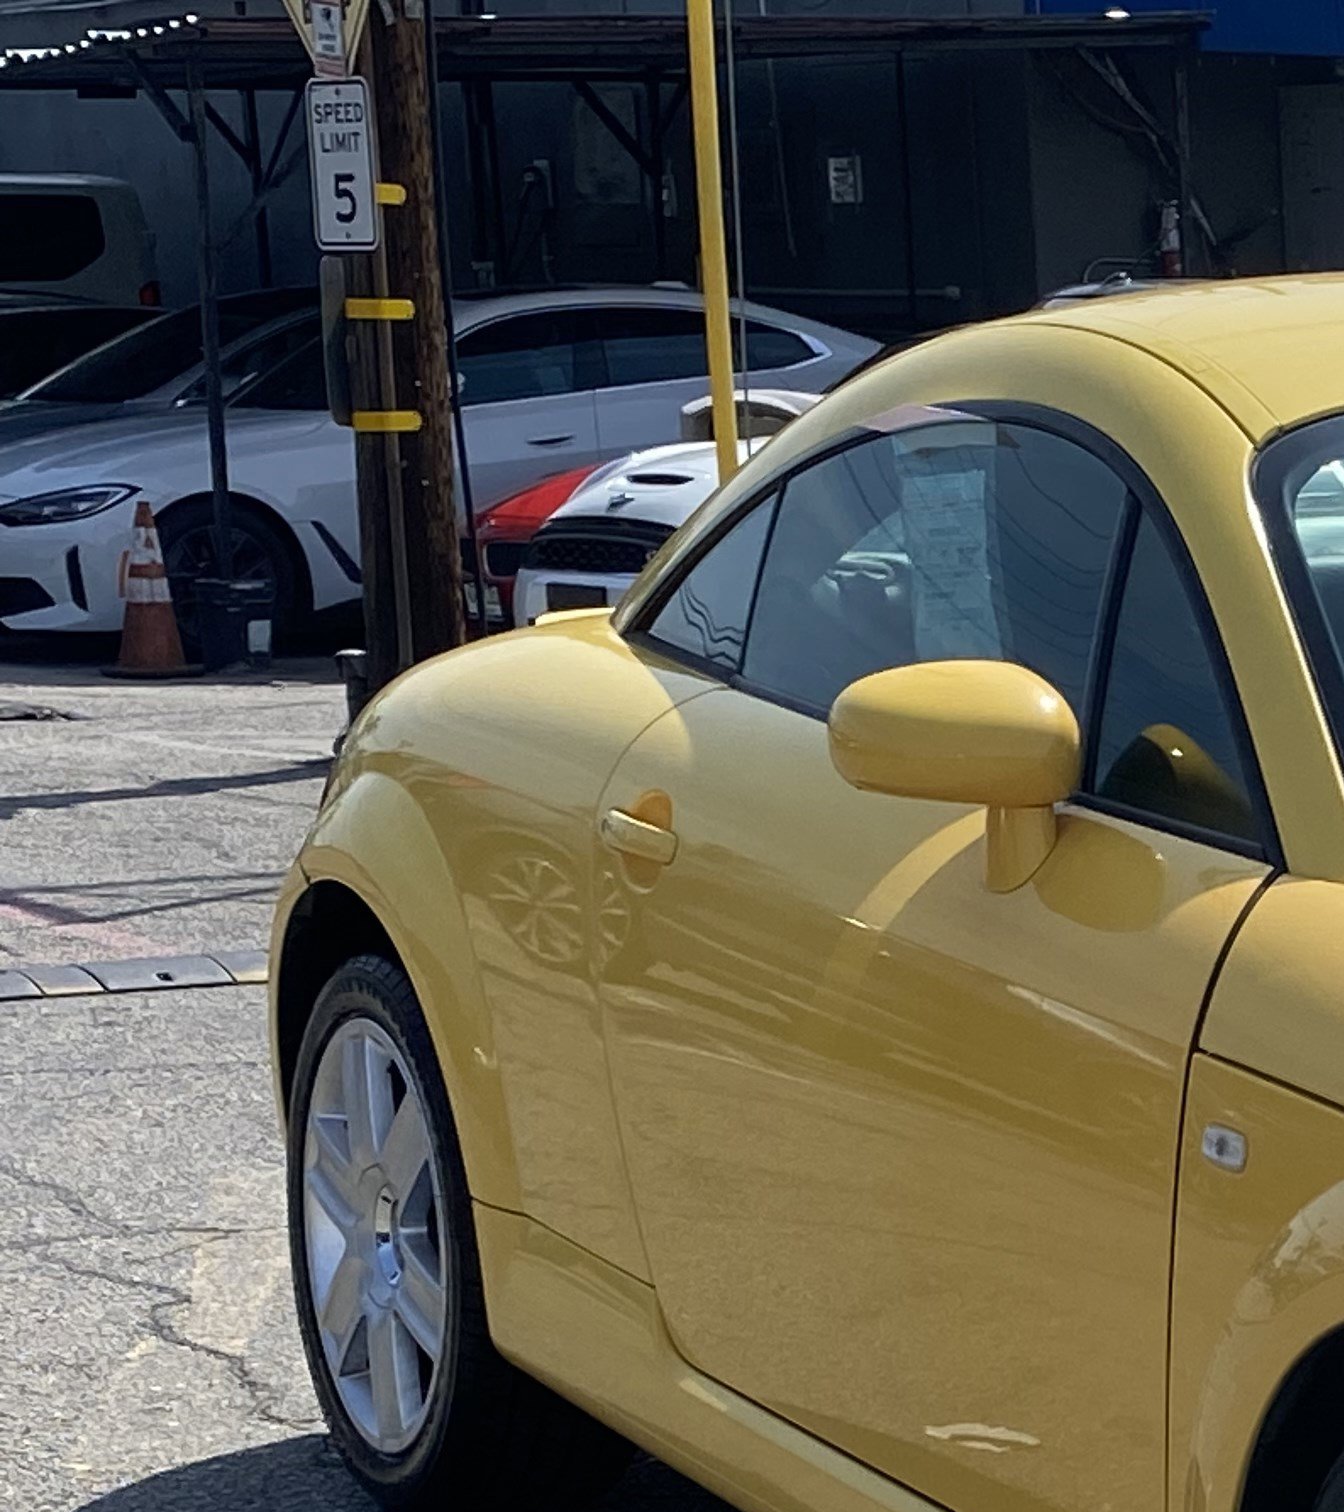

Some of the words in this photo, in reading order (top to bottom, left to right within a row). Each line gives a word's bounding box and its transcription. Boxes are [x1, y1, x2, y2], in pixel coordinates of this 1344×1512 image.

[314, 102, 363, 124] SPEED
[320, 132, 361, 153] LIMIT
[333, 172, 357, 224] 5
